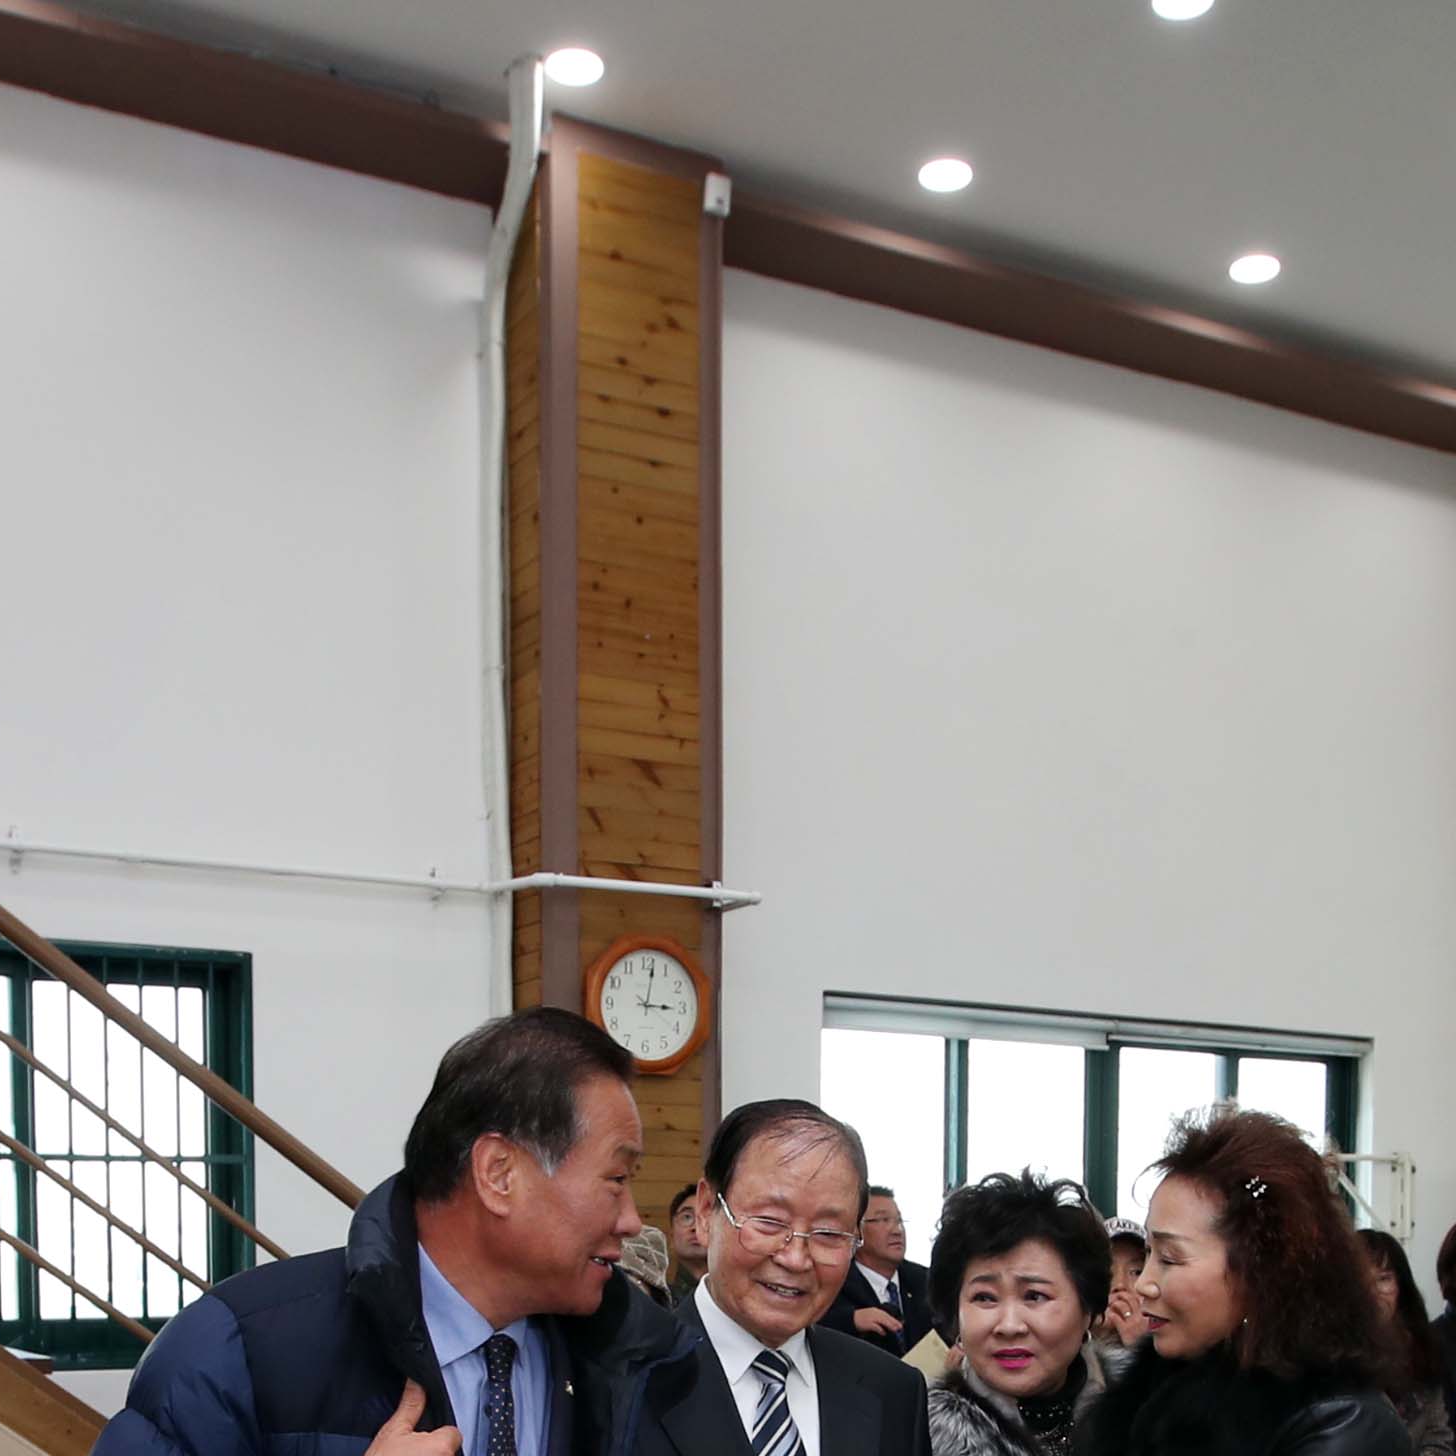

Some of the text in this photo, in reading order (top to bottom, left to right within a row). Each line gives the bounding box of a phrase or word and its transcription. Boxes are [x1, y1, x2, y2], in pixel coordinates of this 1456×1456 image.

[624, 961, 633, 975] 11
[641, 956, 655, 971] 12
[663, 963, 669, 978] 1
[609, 975, 622, 989] 10
[674, 980, 683, 994] 2
[605, 996, 614, 1010] 9
[678, 1001, 687, 1015] 3
[610, 1016, 619, 1031] 8
[672, 1022, 680, 1035] 4
[623, 1034, 632, 1048] 7
[641, 1040, 650, 1053] 6
[659, 1036, 669, 1050] 5
